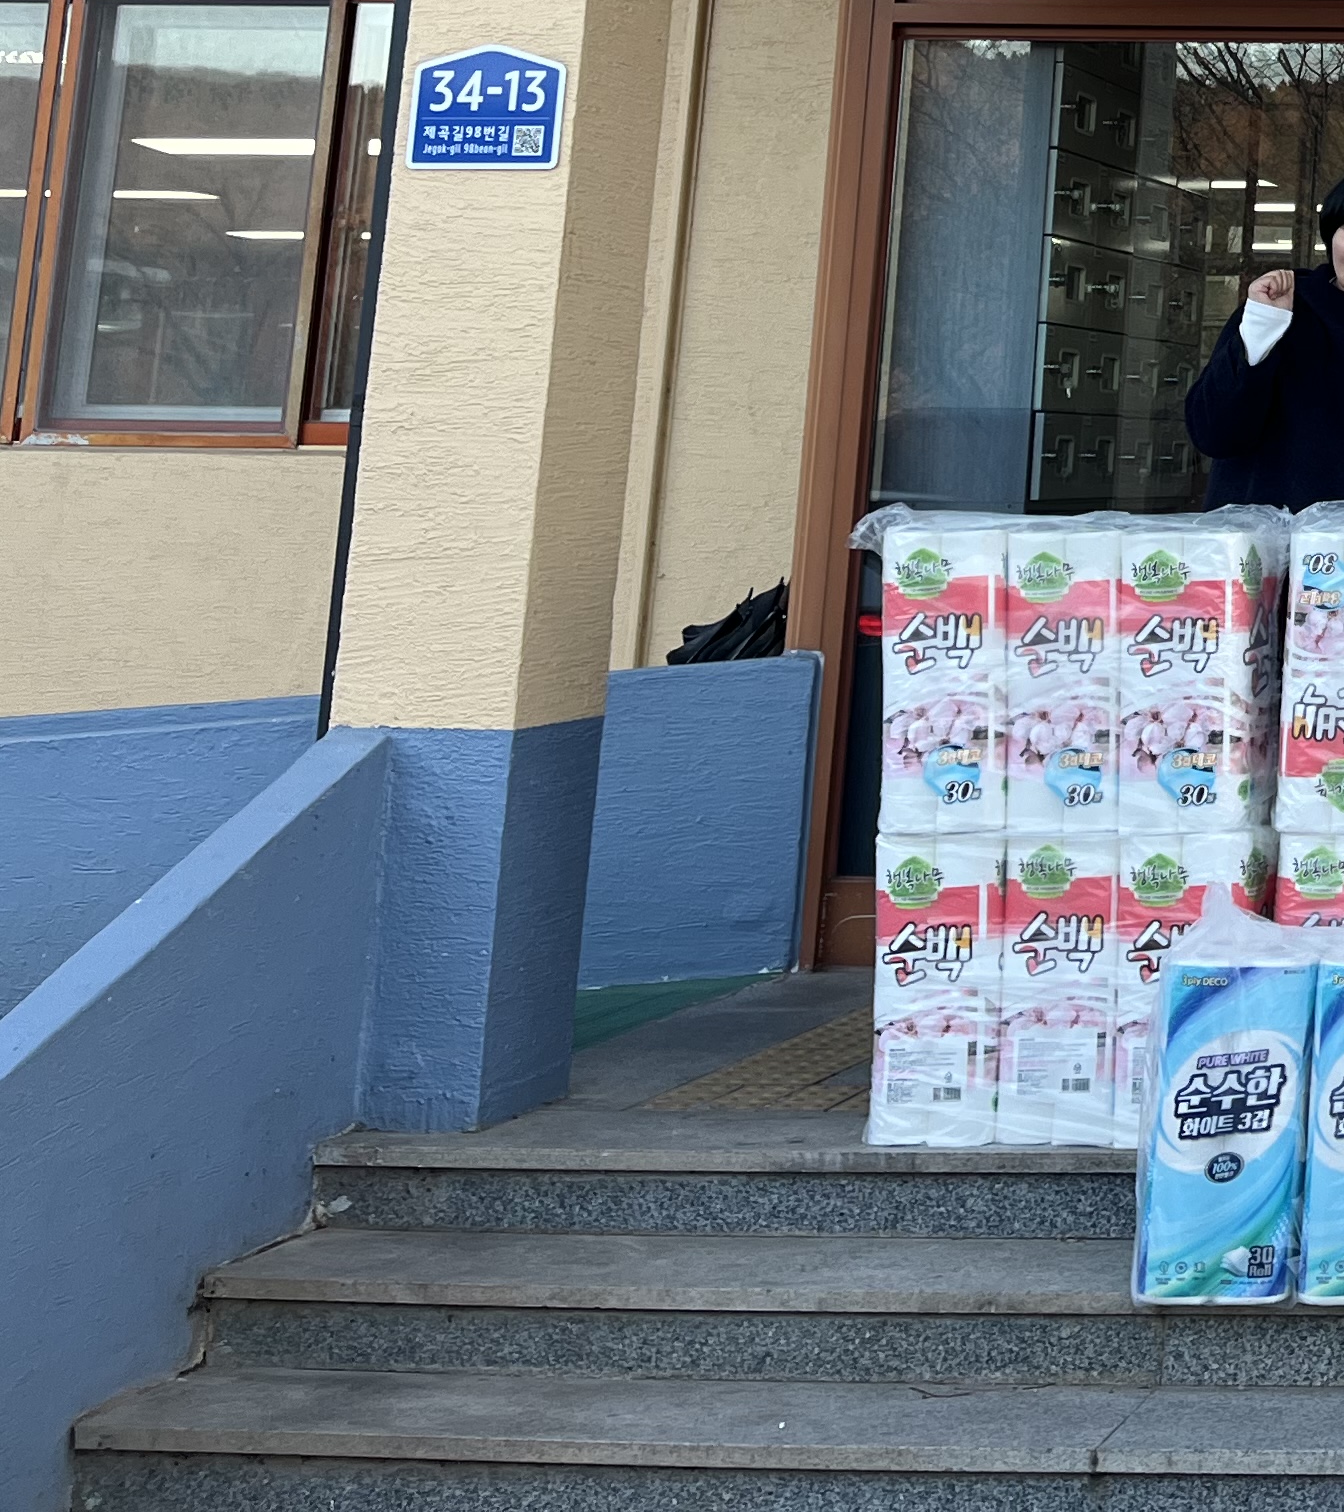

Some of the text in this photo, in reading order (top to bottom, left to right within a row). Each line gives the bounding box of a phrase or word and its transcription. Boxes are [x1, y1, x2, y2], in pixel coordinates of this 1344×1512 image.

[429, 70, 547, 112] 34-13
[894, 556, 954, 579] 행복나무
[1015, 561, 1076, 584] 행복나무
[1130, 559, 1191, 583] 행복나무
[892, 612, 983, 675] 순백
[1014, 616, 1104, 678] 순백
[1127, 614, 1219, 677] 순백
[885, 868, 945, 890] 행복나무
[1018, 857, 1078, 879] 행복나무
[1130, 864, 1190, 888] 행복나무
[882, 921, 973, 987] 순백
[1012, 911, 1104, 977] 순백
[1182, 975, 1228, 987] 3ply DECO
[1198, 1049, 1269, 1070] PURE WHITE
[1175, 1065, 1286, 1116] 순수한
[1179, 1107, 1272, 1140] 화이트 3겹
[1212, 1162, 1237, 1174] 100%
[1250, 1246, 1273, 1264] 30
[1249, 1265, 1272, 1277] Roll
